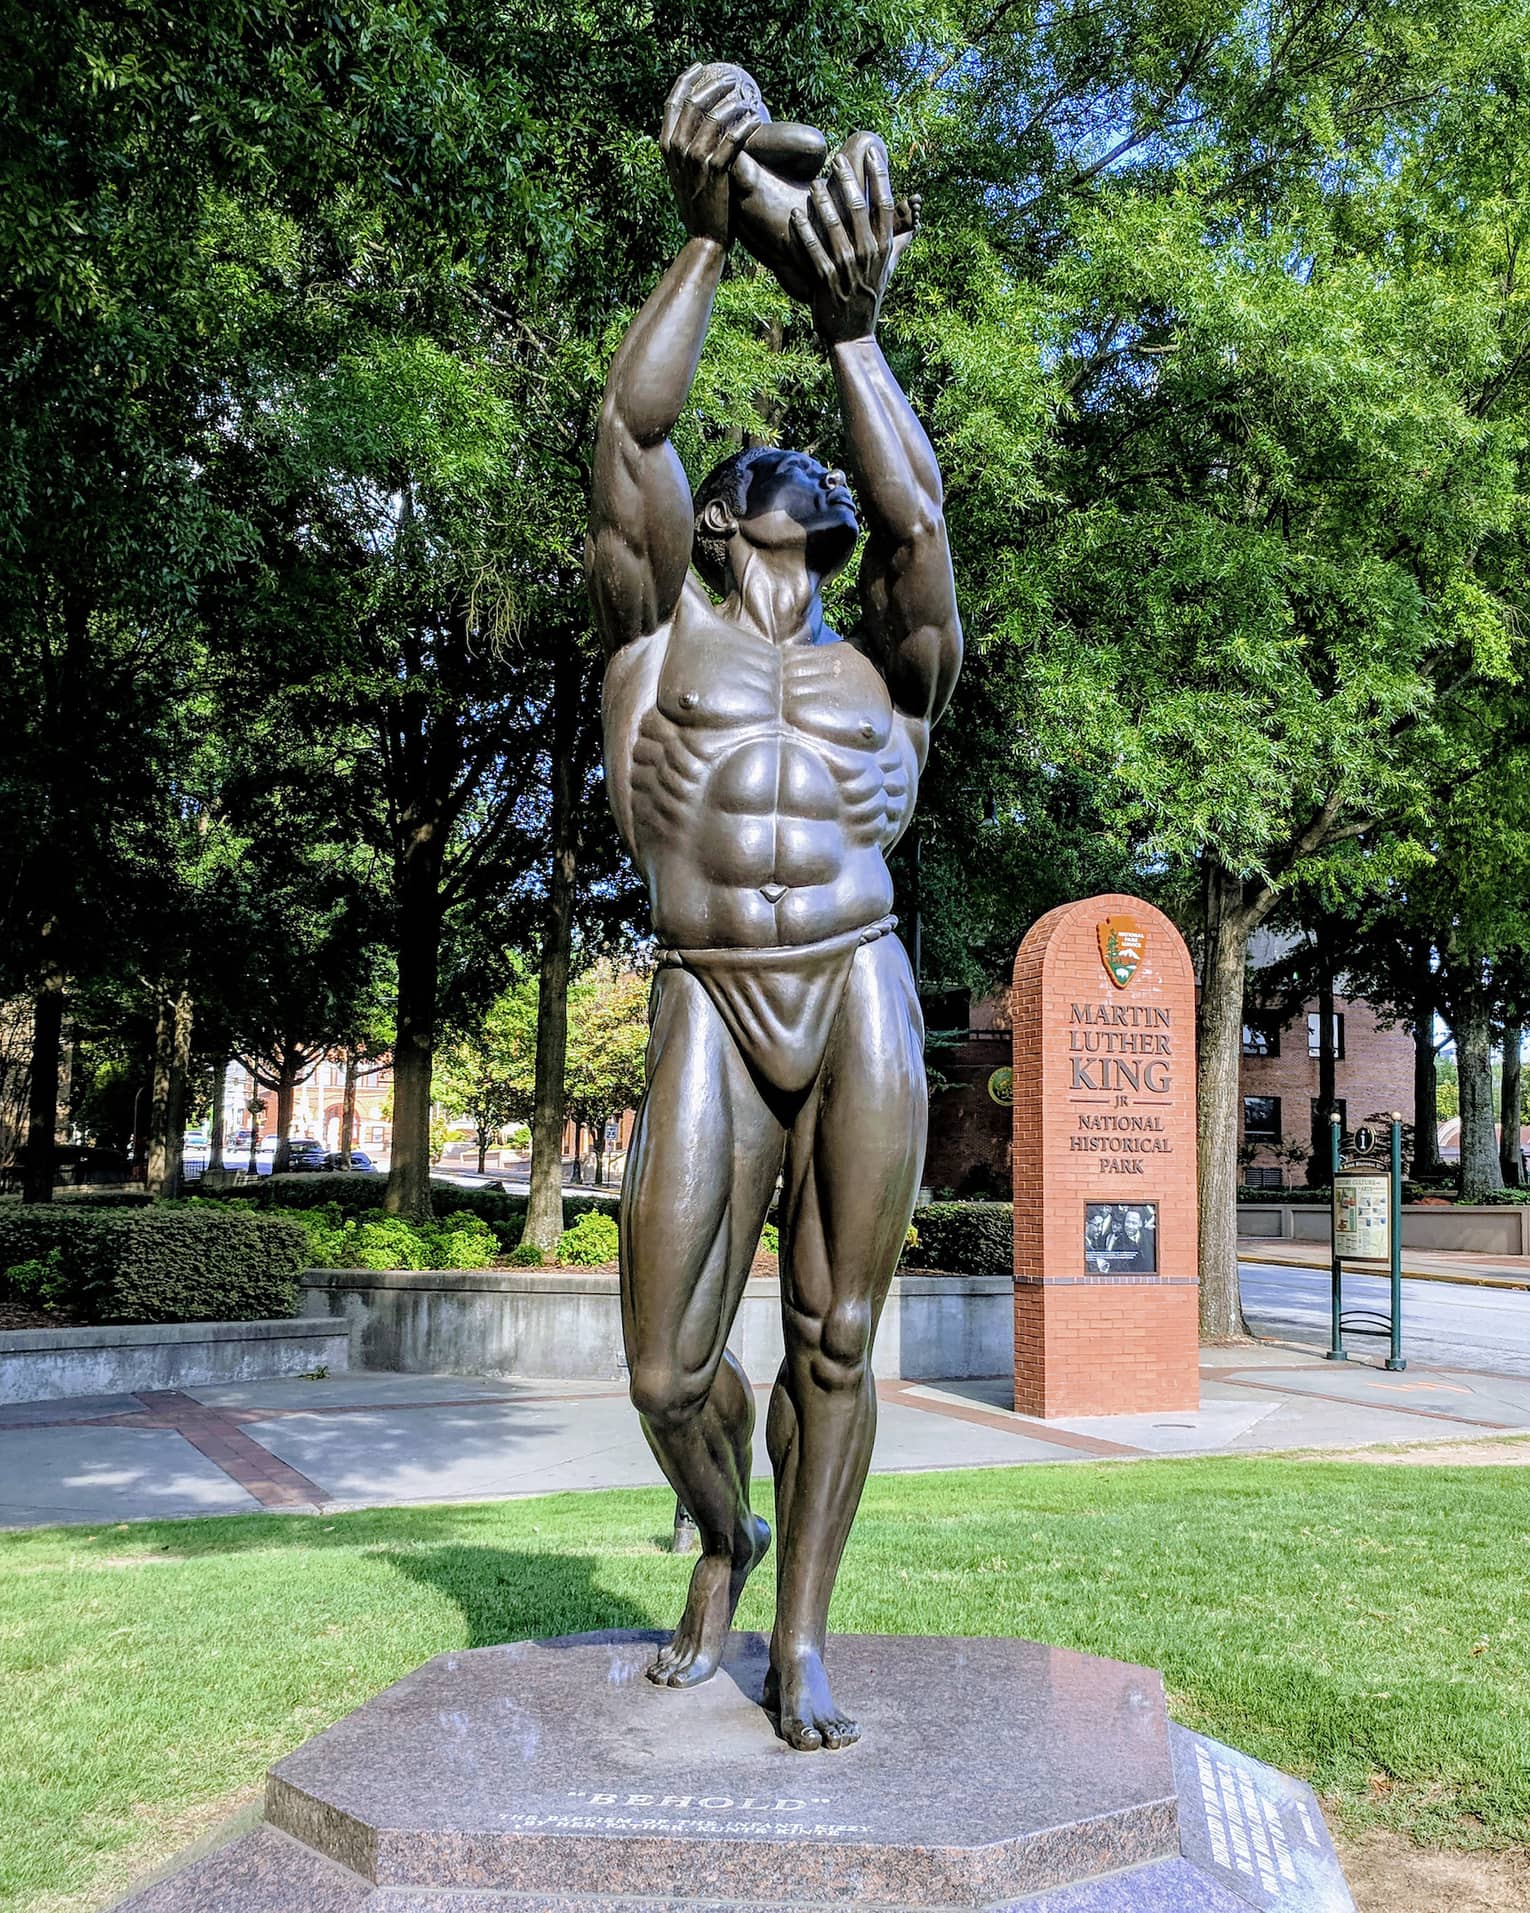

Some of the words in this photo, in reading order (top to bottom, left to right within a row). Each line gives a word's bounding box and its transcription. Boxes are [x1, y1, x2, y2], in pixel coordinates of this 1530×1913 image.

[1069, 1003, 1171, 1028] MARTIN
[1069, 1030, 1172, 1055] LUTHER
[1069, 1056, 1172, 1093] KING
[1114, 1095, 1128, 1108] JR
[1078, 1115, 1164, 1131] NATIONAL
[1069, 1136, 1173, 1153] HISTORICAL
[1099, 1158, 1144, 1174] PARK
[641, 1818, 670, 1826] OF
[677, 1819, 718, 1827] THE
